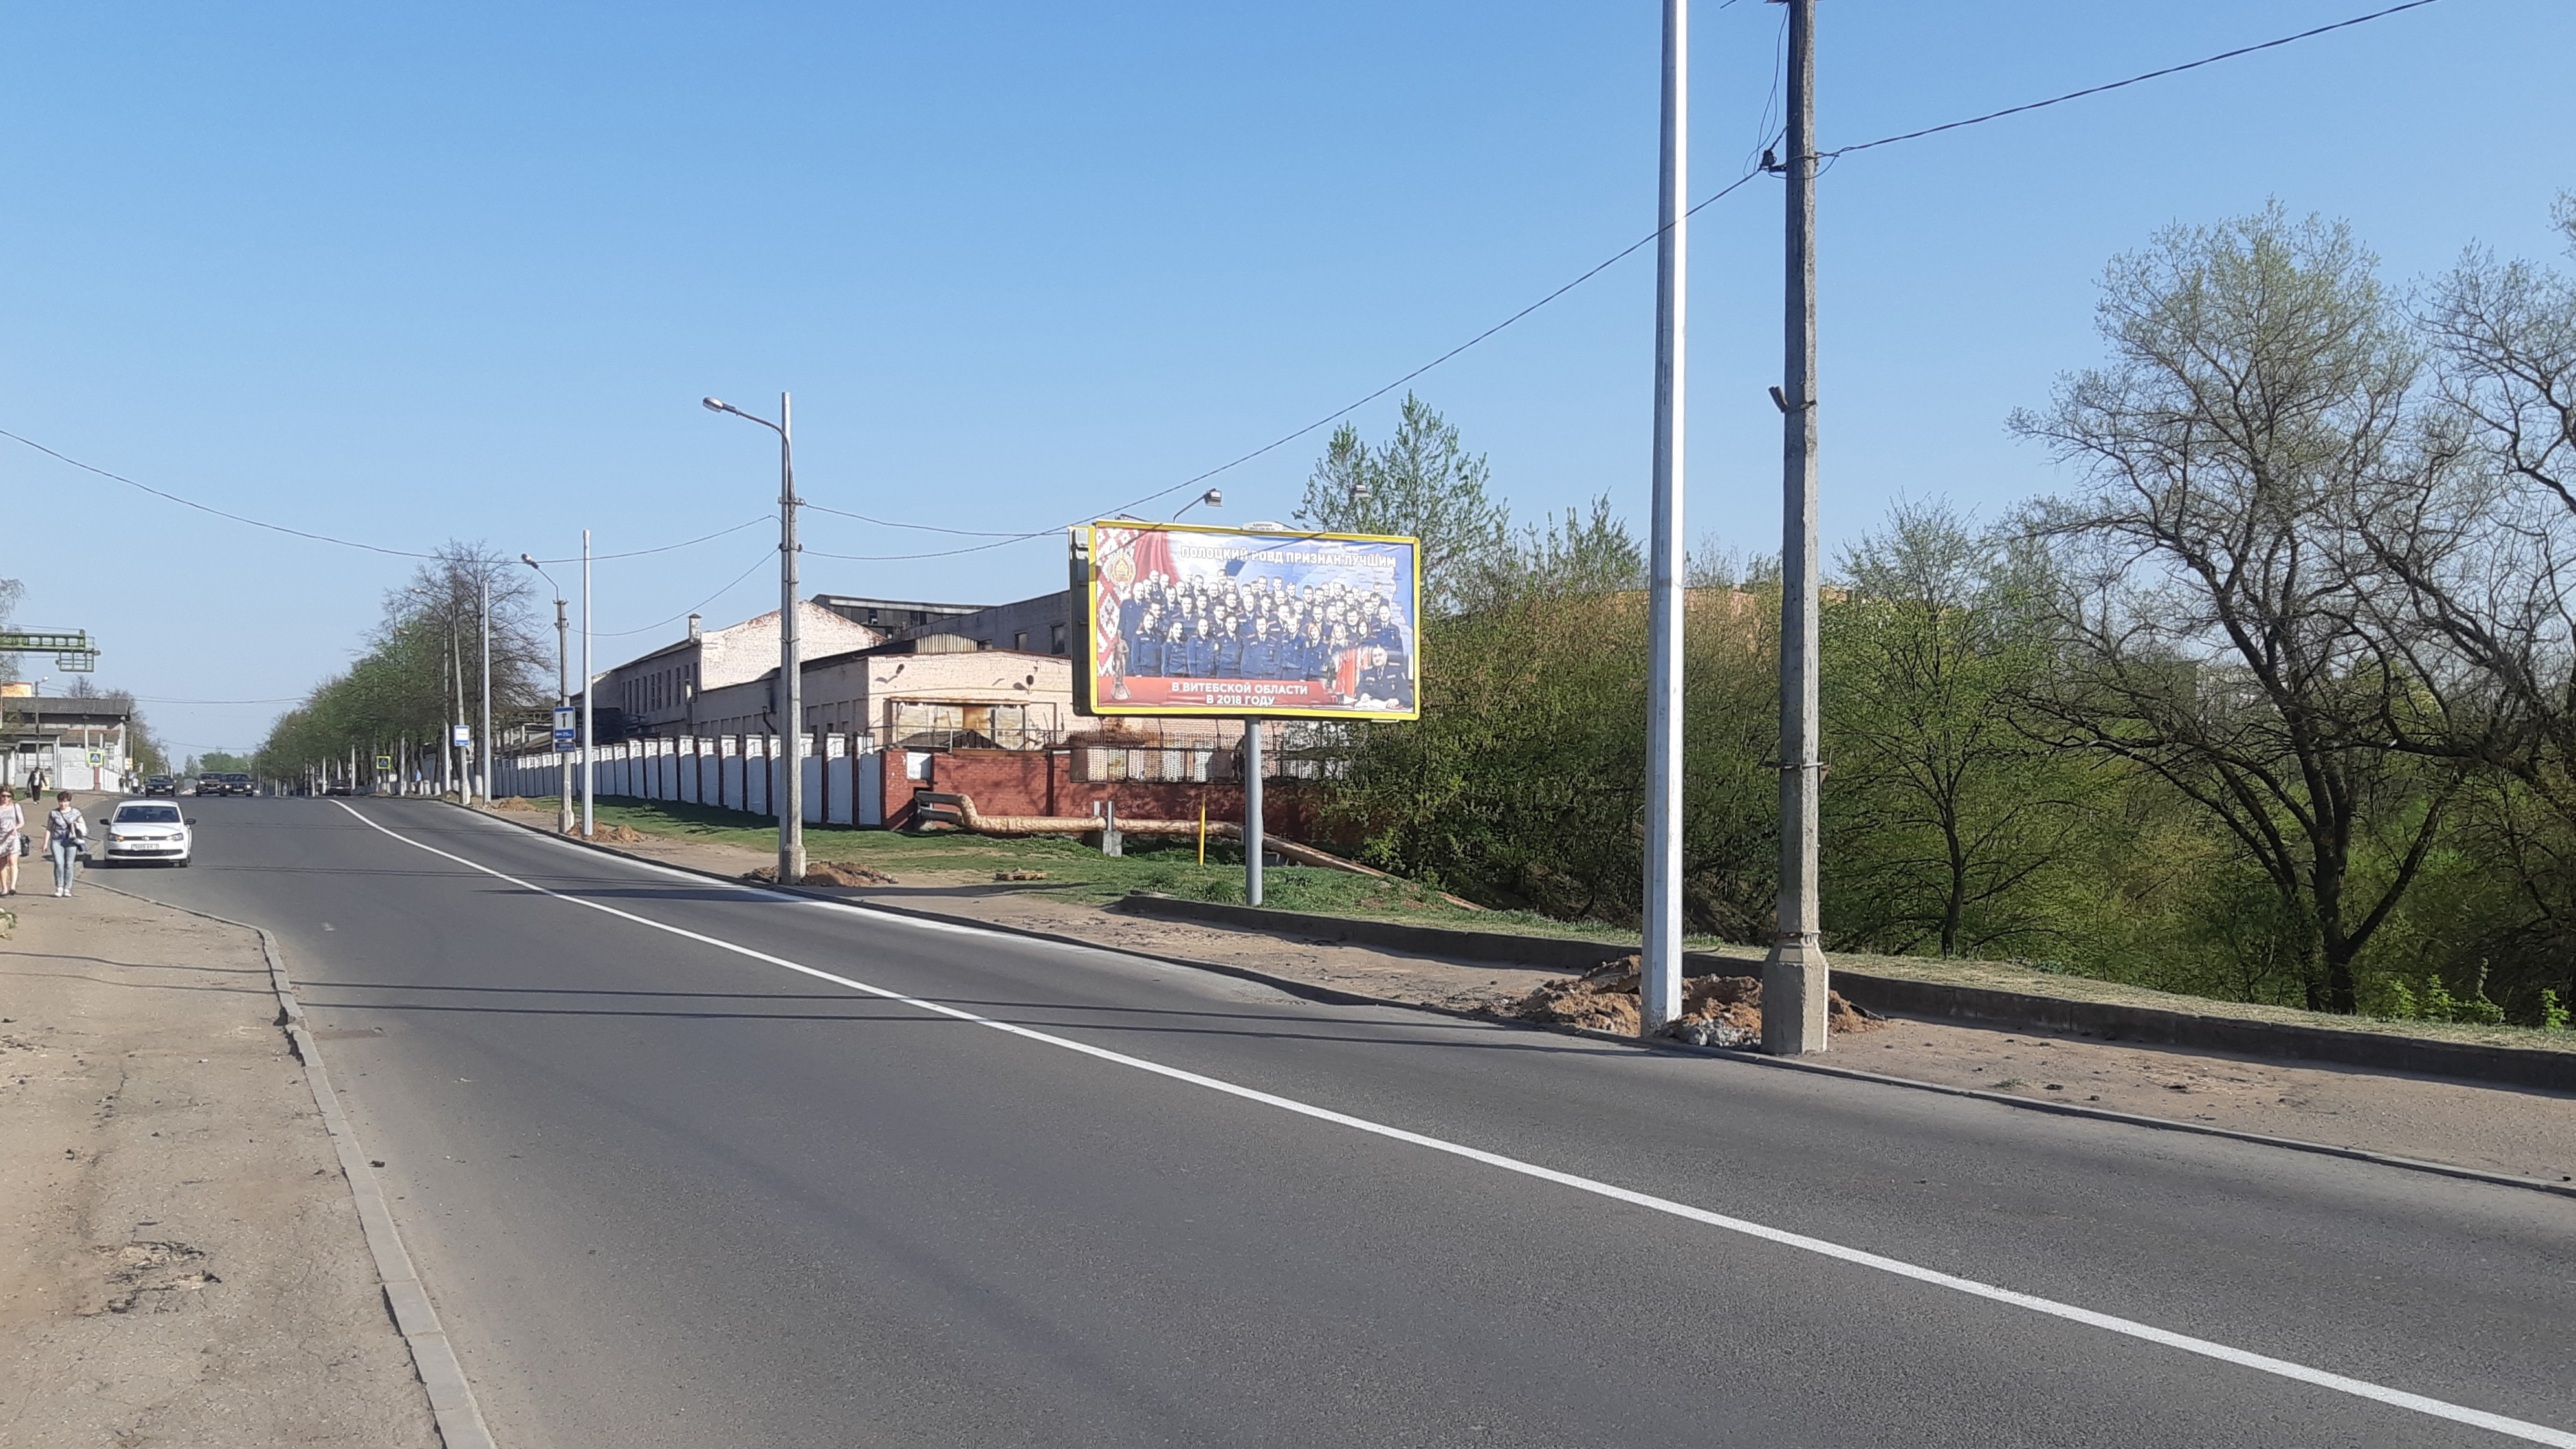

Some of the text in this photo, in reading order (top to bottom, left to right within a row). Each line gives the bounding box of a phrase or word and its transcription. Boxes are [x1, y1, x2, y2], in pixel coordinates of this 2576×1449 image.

[1181, 546, 1396, 567] ПОЛОЦКИЙ РОВД ПРИЗНАН ЛУЧШИМ
[1172, 682, 1308, 695] В ВИТЕБСКОЙ ОБЛАСТИ
[1206, 695, 1275, 706] В 2018 ГОДУ
